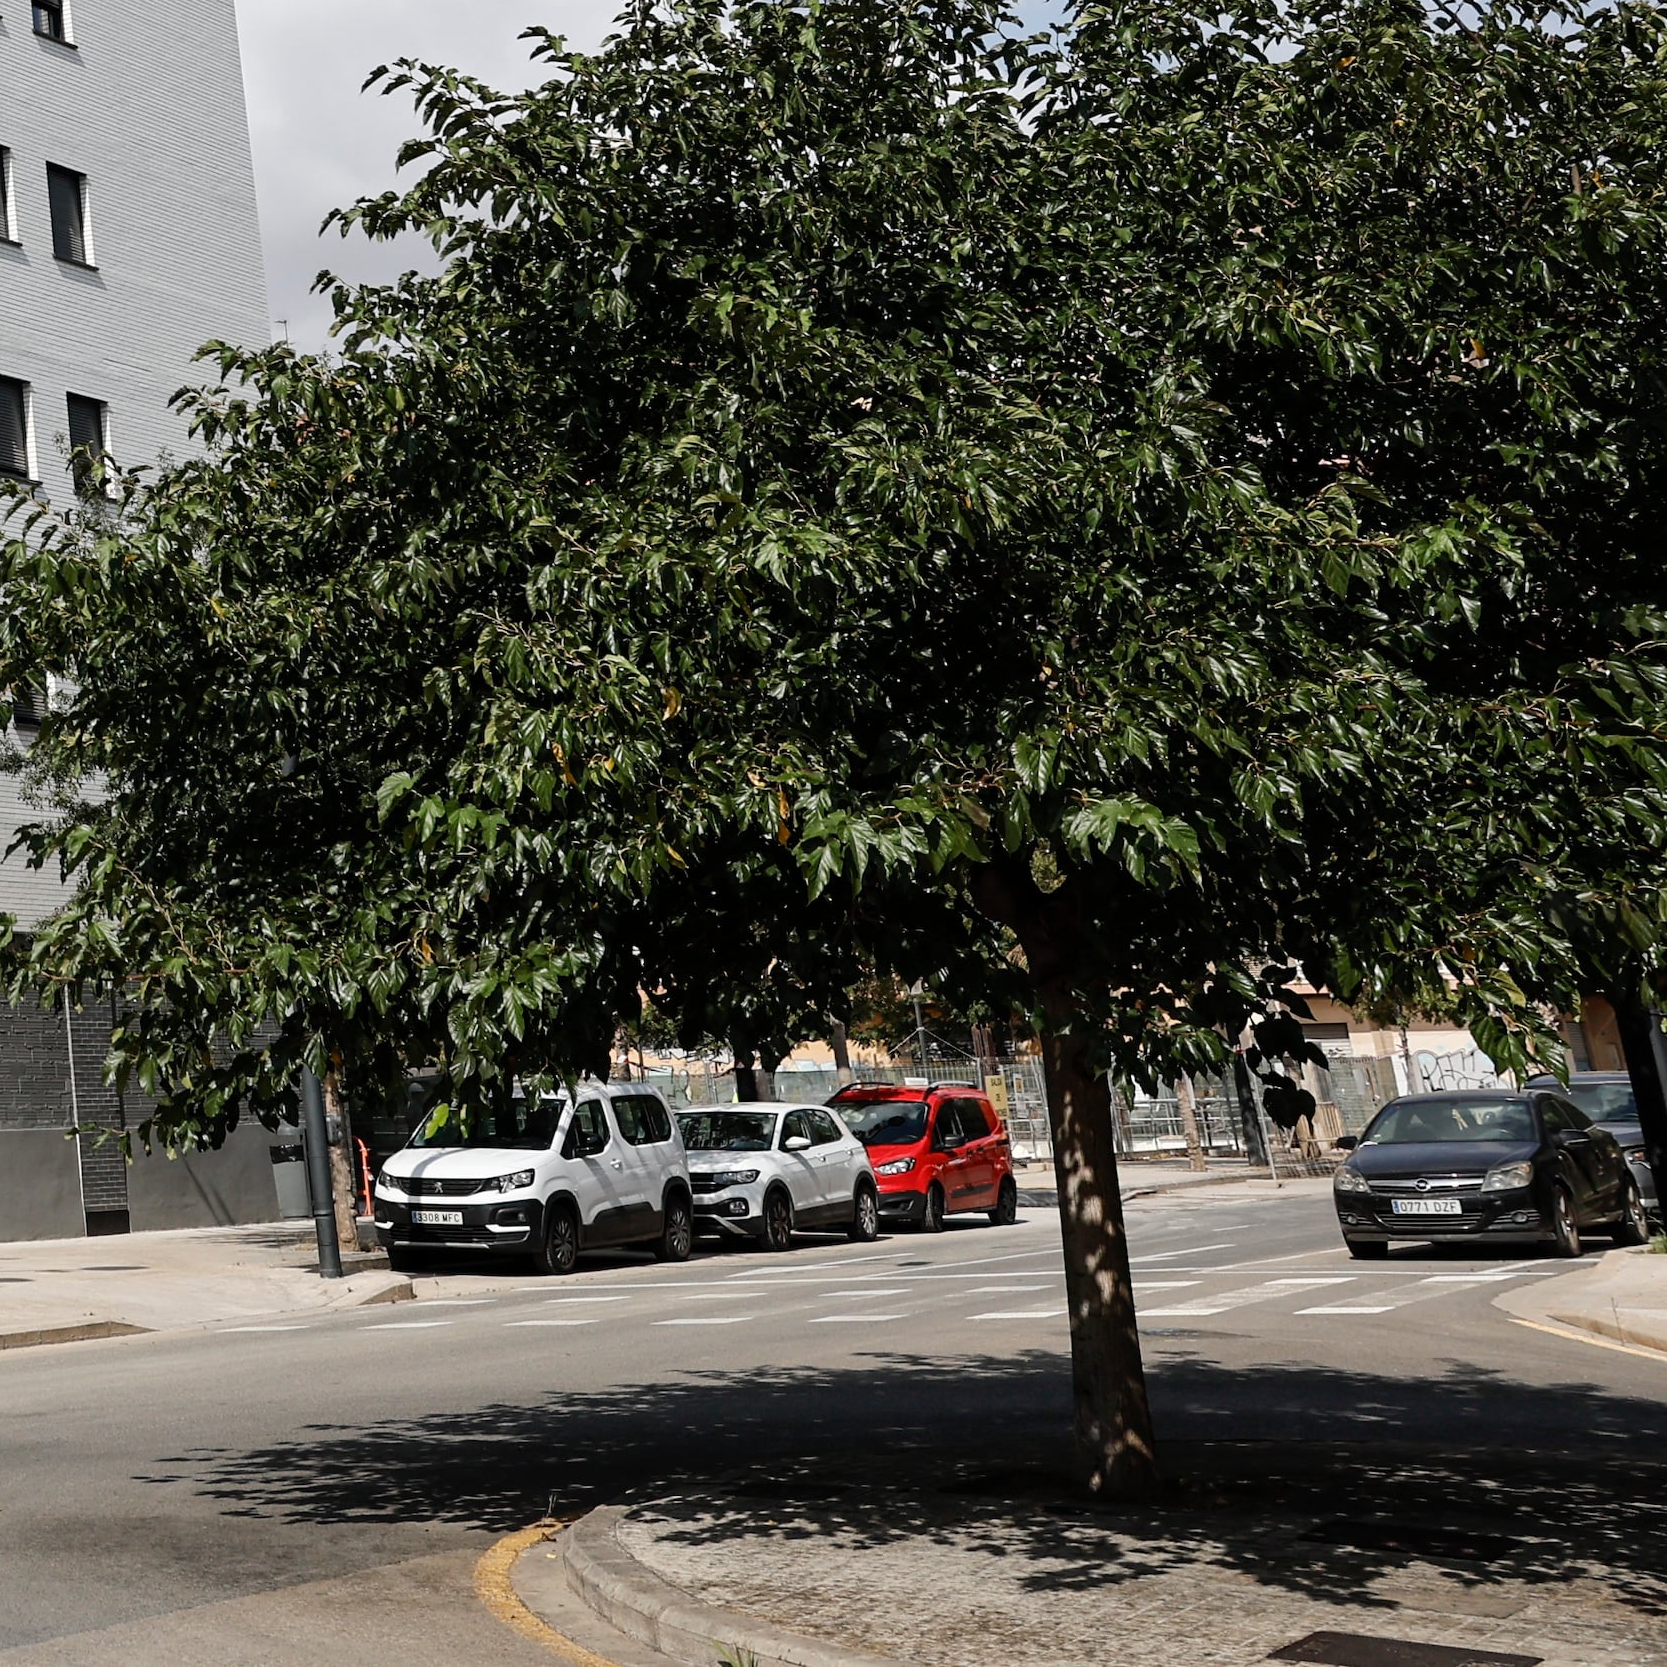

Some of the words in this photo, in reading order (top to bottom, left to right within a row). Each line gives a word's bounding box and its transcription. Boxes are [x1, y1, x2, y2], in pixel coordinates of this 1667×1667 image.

[1399, 1201, 1429, 1212] 0771
[1433, 1201, 1457, 1212] DZF
[417, 1213, 439, 1222] 3308
[442, 1214, 460, 1223] MFC
